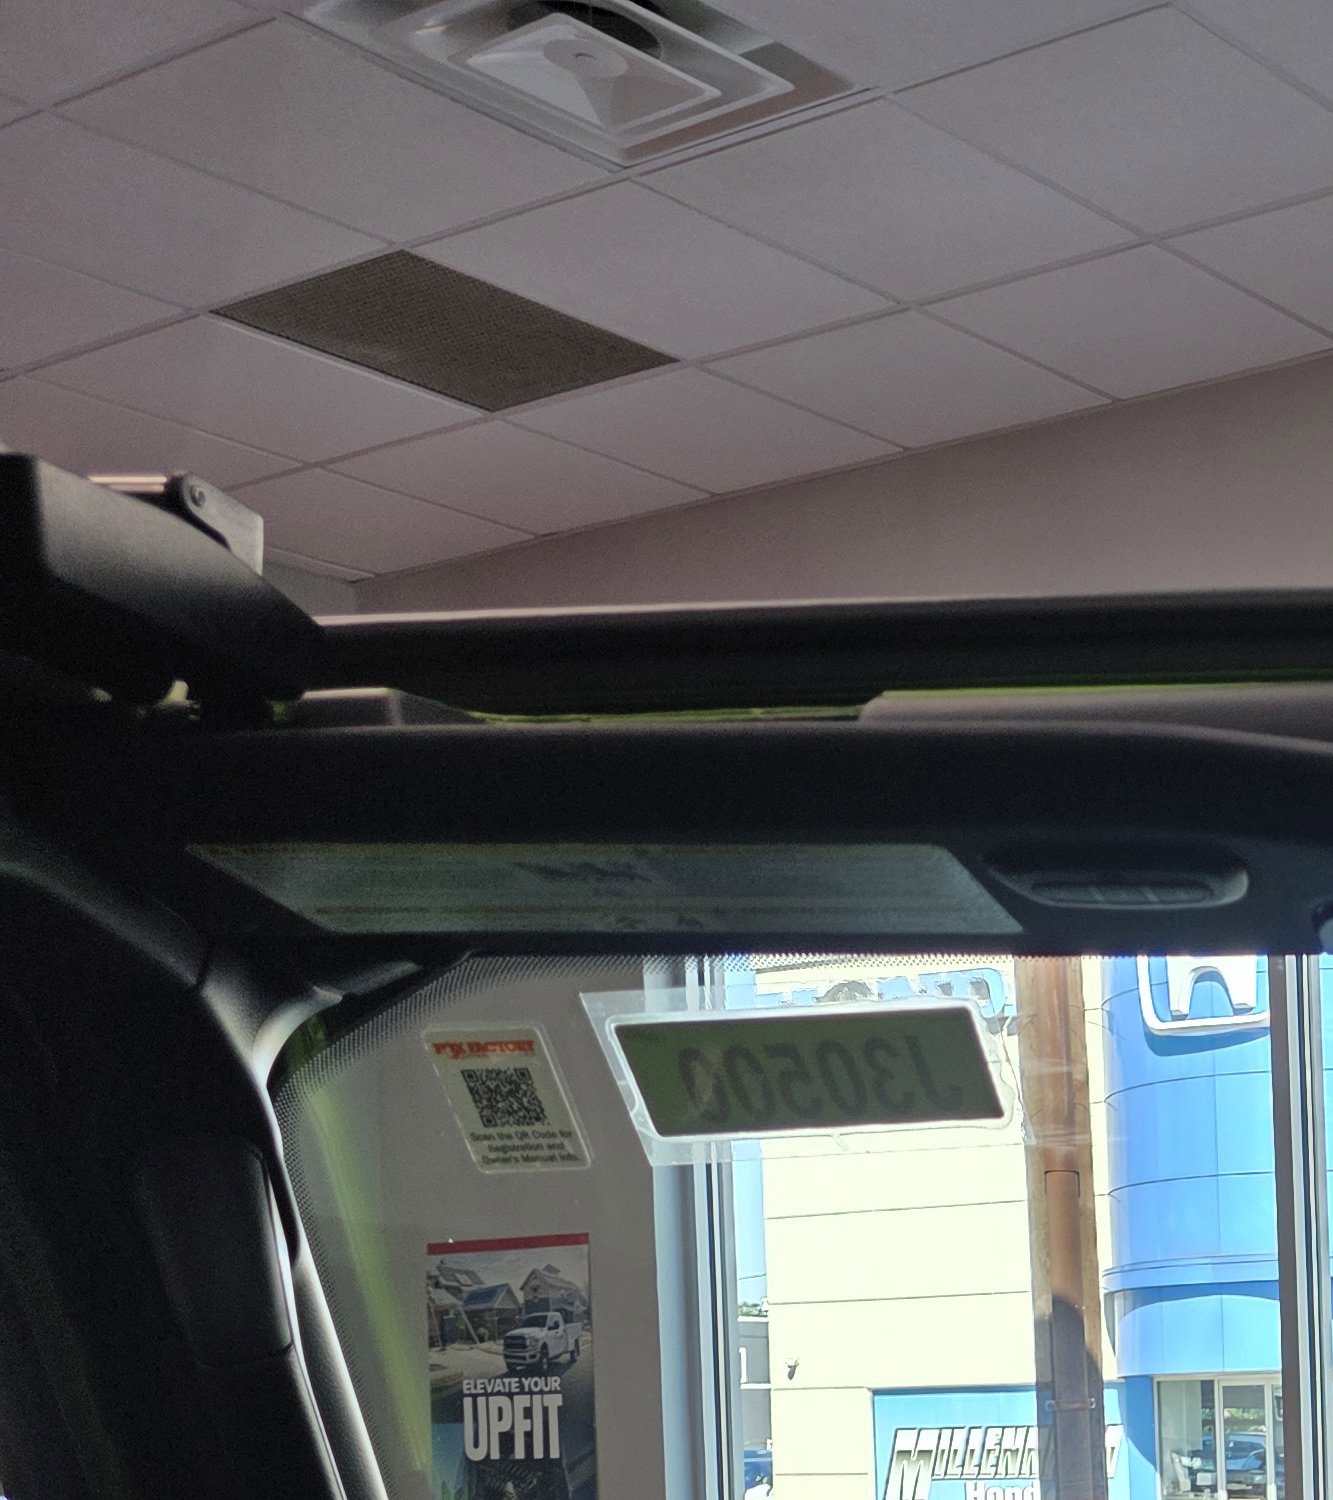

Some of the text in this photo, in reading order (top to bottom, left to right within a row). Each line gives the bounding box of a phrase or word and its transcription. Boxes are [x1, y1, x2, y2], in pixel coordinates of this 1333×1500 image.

[470, 1132, 496, 1142] Scan
[497, 1131, 513, 1140] the
[515, 1131, 529, 1142] QR
[532, 1131, 557, 1140] Code
[463, 1376, 561, 1394] ELEVATE YOUR
[463, 1394, 563, 1462] UPFIT
